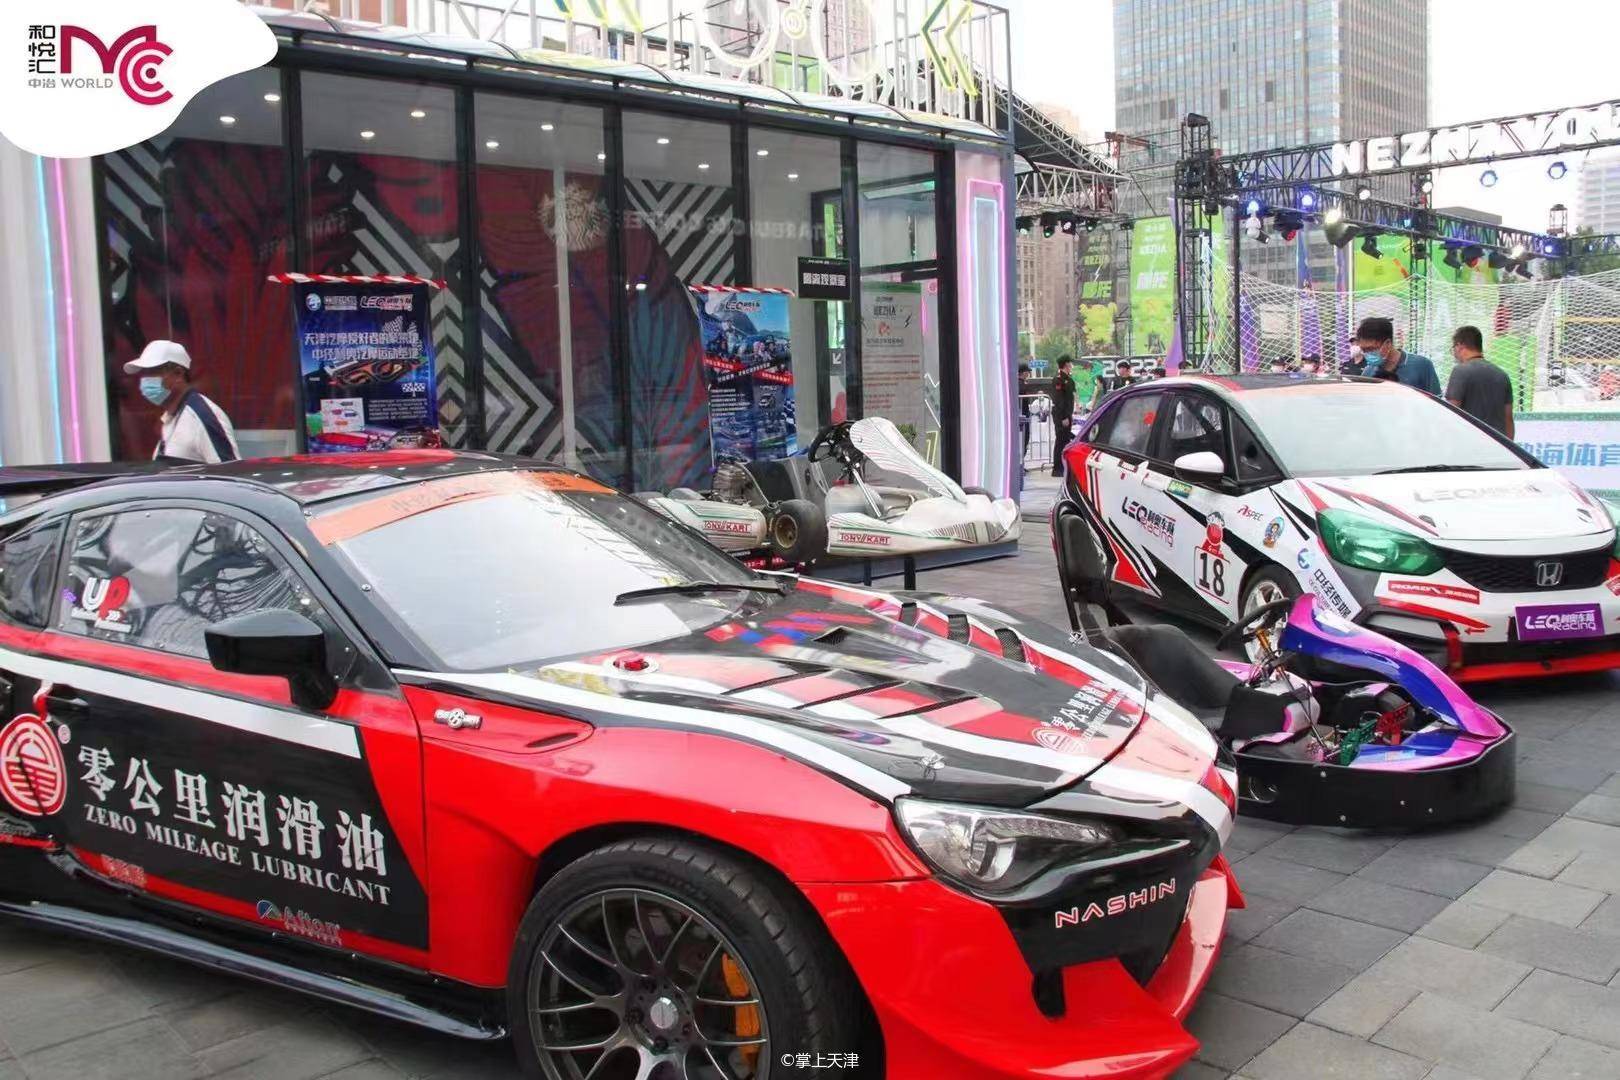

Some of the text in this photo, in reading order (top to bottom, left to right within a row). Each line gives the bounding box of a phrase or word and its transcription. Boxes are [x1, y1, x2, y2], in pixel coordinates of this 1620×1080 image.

[1103, 360, 1158, 377] 222
[1199, 552, 1225, 597] 18
[78, 745, 387, 876] 零公里润滑油
[84, 803, 391, 906] ZERO MILEAGE LUBRICANT
[1055, 878, 1176, 928] NASHIN
